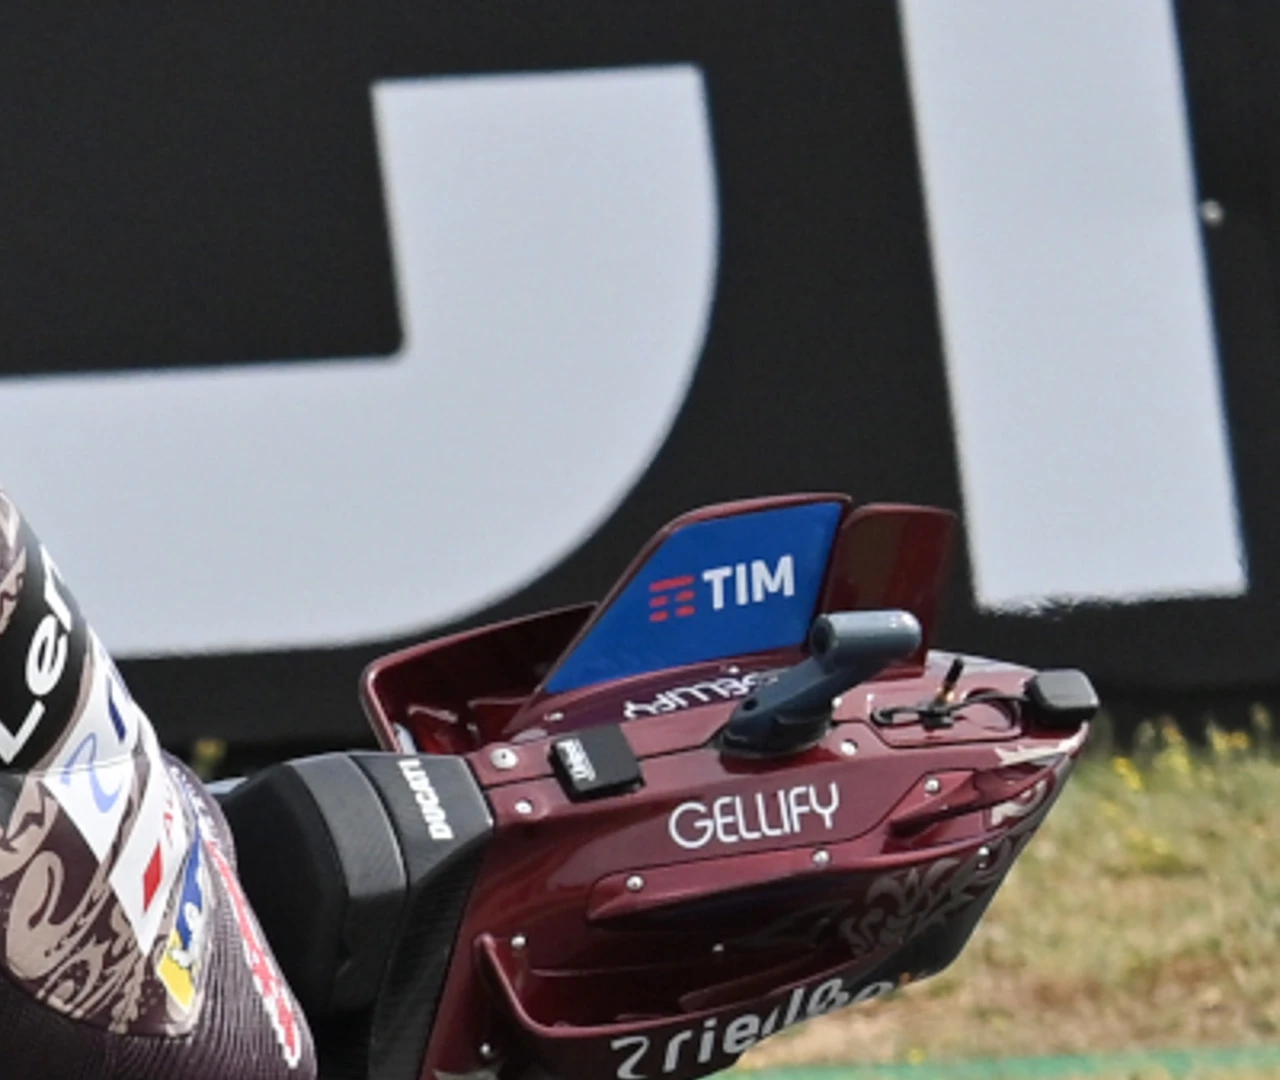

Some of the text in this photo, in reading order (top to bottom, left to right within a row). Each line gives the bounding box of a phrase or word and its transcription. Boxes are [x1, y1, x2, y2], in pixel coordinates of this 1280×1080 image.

[703, 555, 796, 610] TIM
[398, 759, 454, 841] DUCATI
[668, 782, 840, 850] GELLIFY
